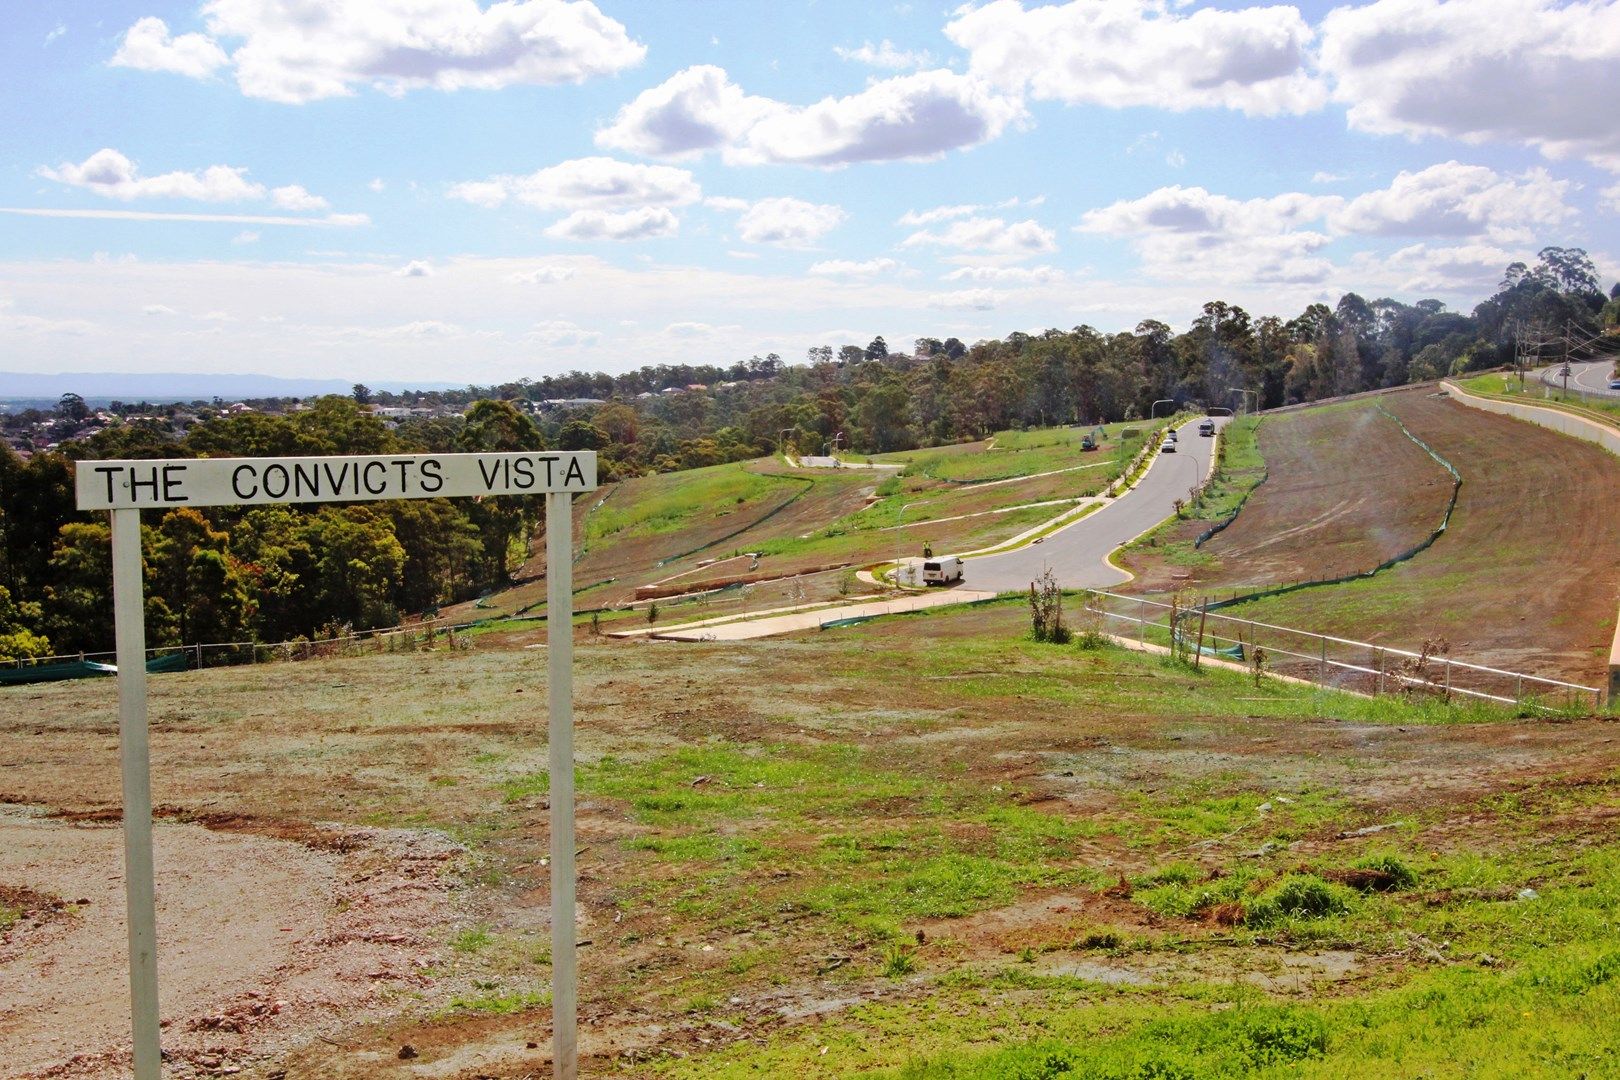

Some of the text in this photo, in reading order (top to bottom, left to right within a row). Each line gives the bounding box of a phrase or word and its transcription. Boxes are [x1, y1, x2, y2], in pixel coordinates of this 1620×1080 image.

[94, 456, 585, 503] THE CONVICTS VISTA
